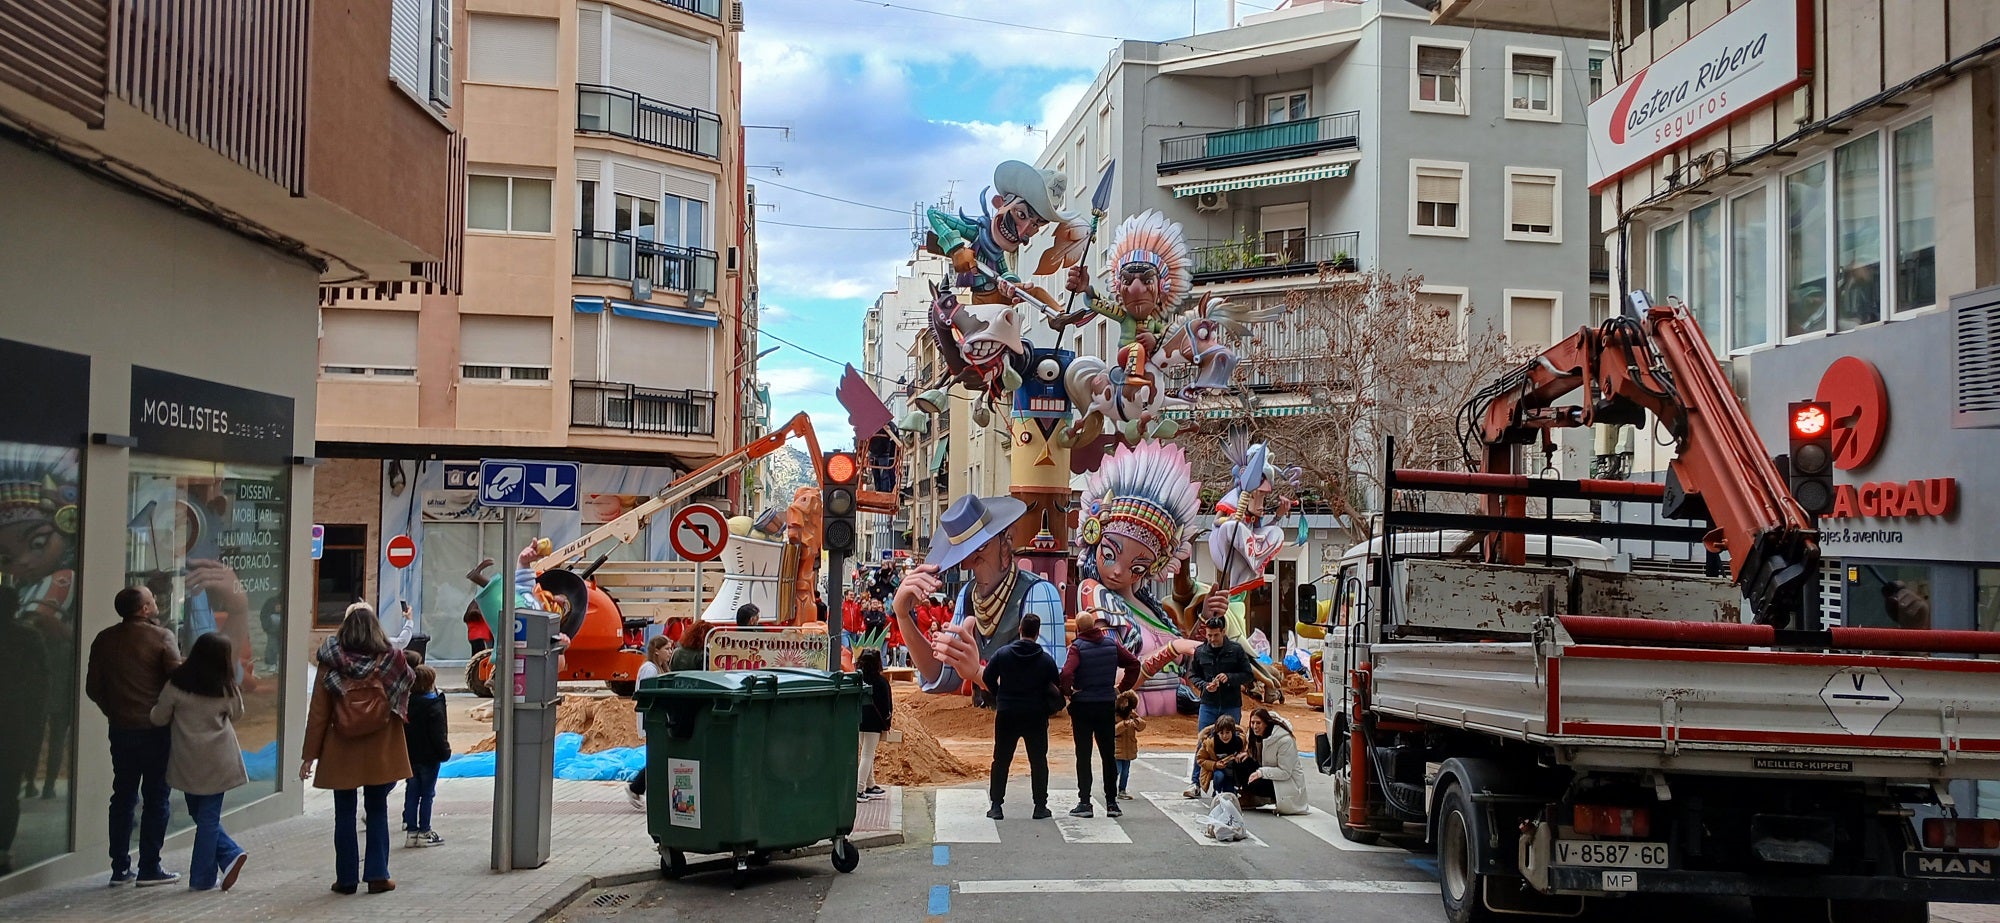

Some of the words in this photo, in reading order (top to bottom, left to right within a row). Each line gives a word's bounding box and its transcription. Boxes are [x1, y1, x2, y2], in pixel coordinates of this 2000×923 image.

[1695, 33, 1767, 92] Ribera
[1655, 91, 1727, 143] seguros
[240, 484, 273, 500] DISSENY
[232, 508, 272, 522] MOBILIARI
[1842, 528, 1851, 543] &
[1852, 528, 1903, 543] aventura
[563, 544, 576, 556] JLG
[577, 536, 592, 550] LIFT
[222, 552, 271, 571] DECORACIÓ
[233, 578, 270, 594] DESCANS
[715, 636, 823, 655] Programació
[1852, 673, 1865, 691] V
[1757, 759, 1849, 770] MEILLER-KIPPER
[1919, 857, 1992, 874] MAN
[1606, 875, 1633, 888] MP
